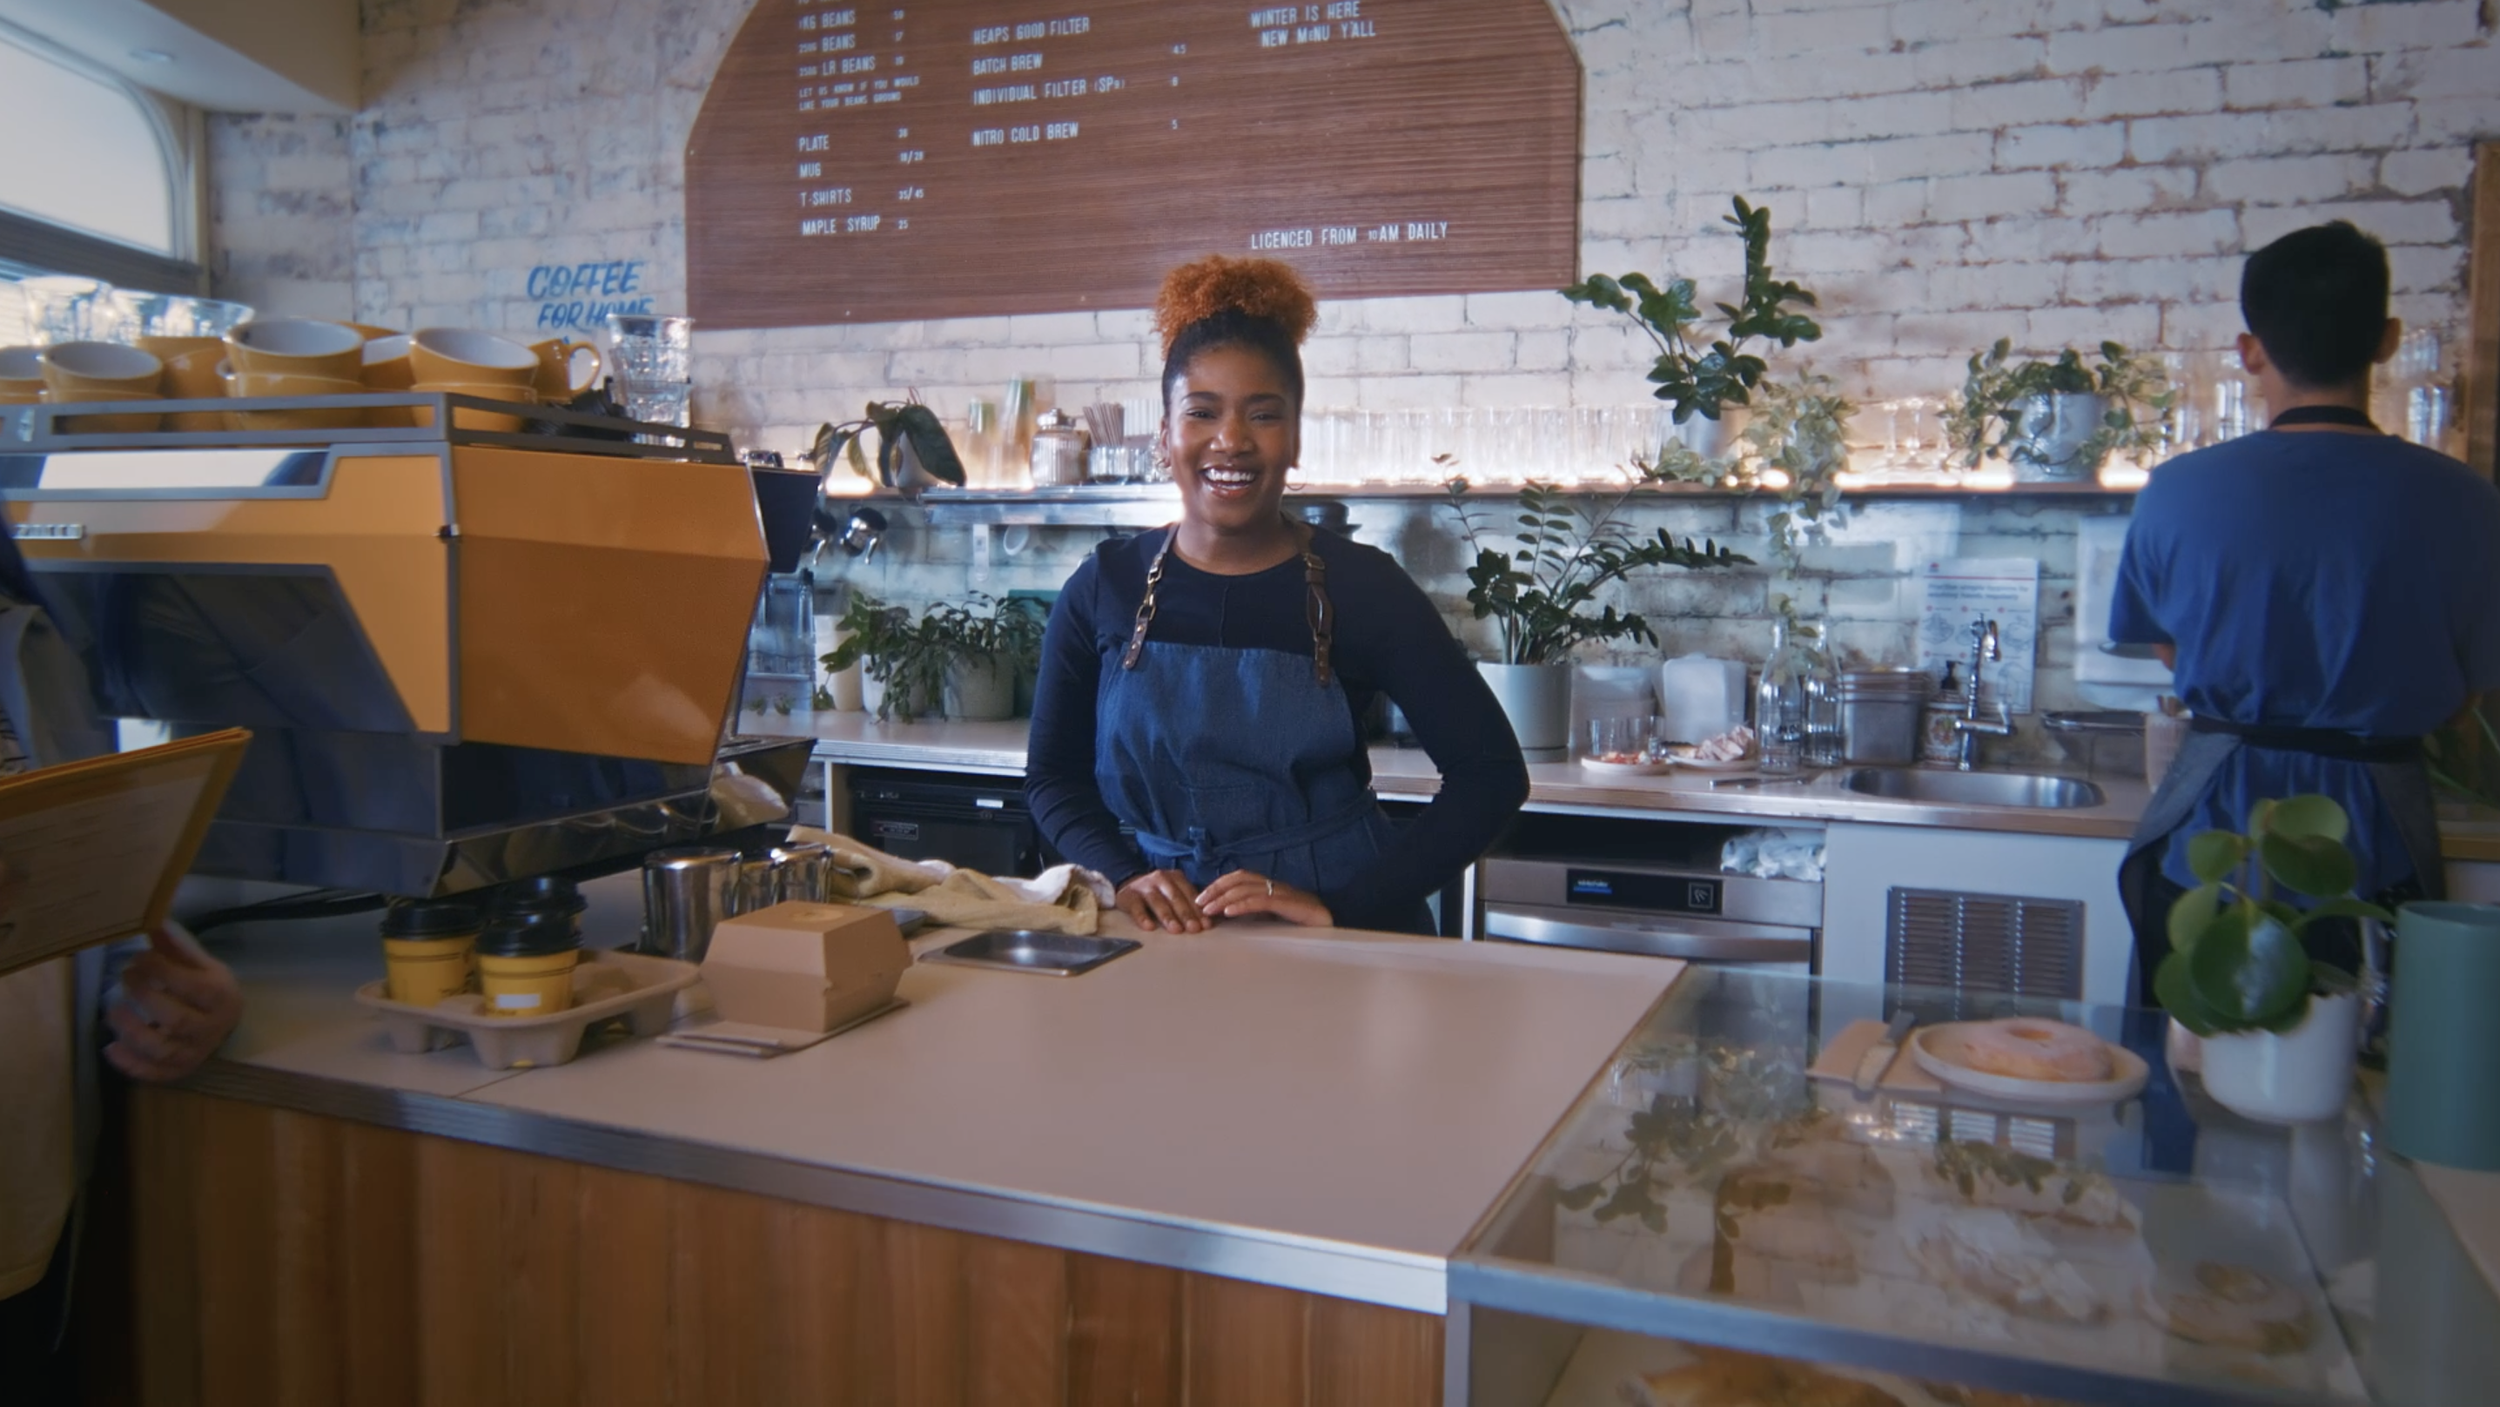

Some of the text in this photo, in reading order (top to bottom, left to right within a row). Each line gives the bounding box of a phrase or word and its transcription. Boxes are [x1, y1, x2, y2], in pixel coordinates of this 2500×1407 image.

[822, 10, 856, 28] BEANS
[1250, 1, 1361, 28] WINTER IS HERE
[973, 17, 1090, 45] HEAPS GOOD FILTER
[1261, 29, 1289, 48] NEW
[1341, 21, 1376, 39] Y'ALL
[822, 34, 856, 52] BEANS
[842, 56, 876, 74] BEANS
[973, 56, 1007, 76] BATCH
[1011, 53, 1043, 71] BREW
[799, 76, 920, 98] LET US KNOW IF YOU WOULD
[973, 85, 1038, 106] INDIVIDUAL
[1045, 79, 1087, 98] FILTER
[799, 91, 902, 111] LIKE YOUR BEANS GROUND
[799, 135, 830, 152] PLATE
[973, 119, 1179, 146] NITRO COLD BREW 5
[799, 162, 822, 178] MUG
[801, 188, 853, 207] T-SHIRTS
[802, 219, 837, 236] MAPLE
[847, 215, 881, 232] SYRUP
[1251, 222, 1448, 250] LICENCED FROM 10AM DAILY
[527, 260, 645, 301] COFFEE
[537, 301, 593, 335] FOR
